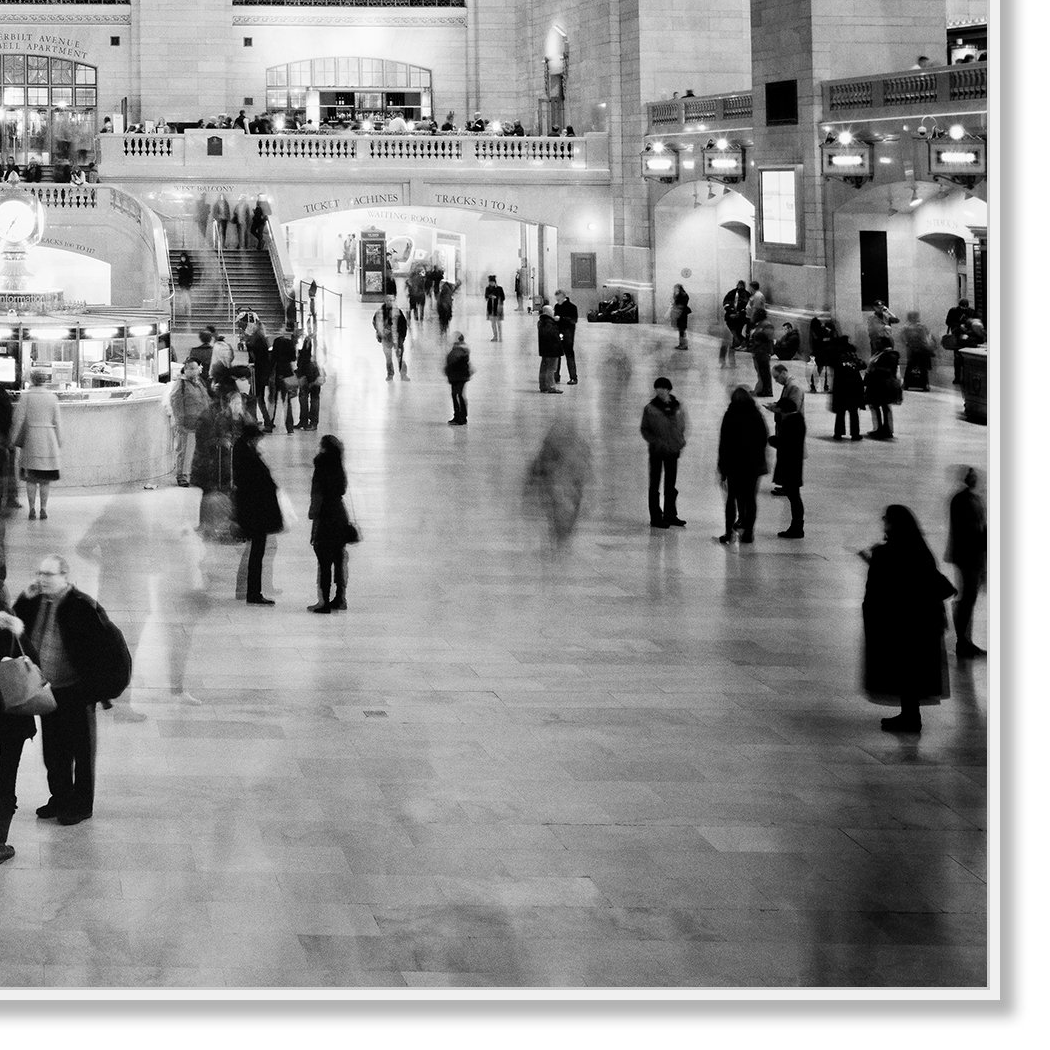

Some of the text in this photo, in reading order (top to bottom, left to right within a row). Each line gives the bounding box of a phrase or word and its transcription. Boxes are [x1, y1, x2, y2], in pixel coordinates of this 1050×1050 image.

[39, 34, 81, 49] AVENUE
[26, 42, 89, 60] APARTMENT
[196, 185, 235, 193] BALCONY
[303, 193, 399, 214] TICKET ACHINES
[435, 193, 520, 214] TRACKS 31 TO 42
[367, 208, 438, 225] WAITING ROOM
[41, 237, 64, 247] RACKS
